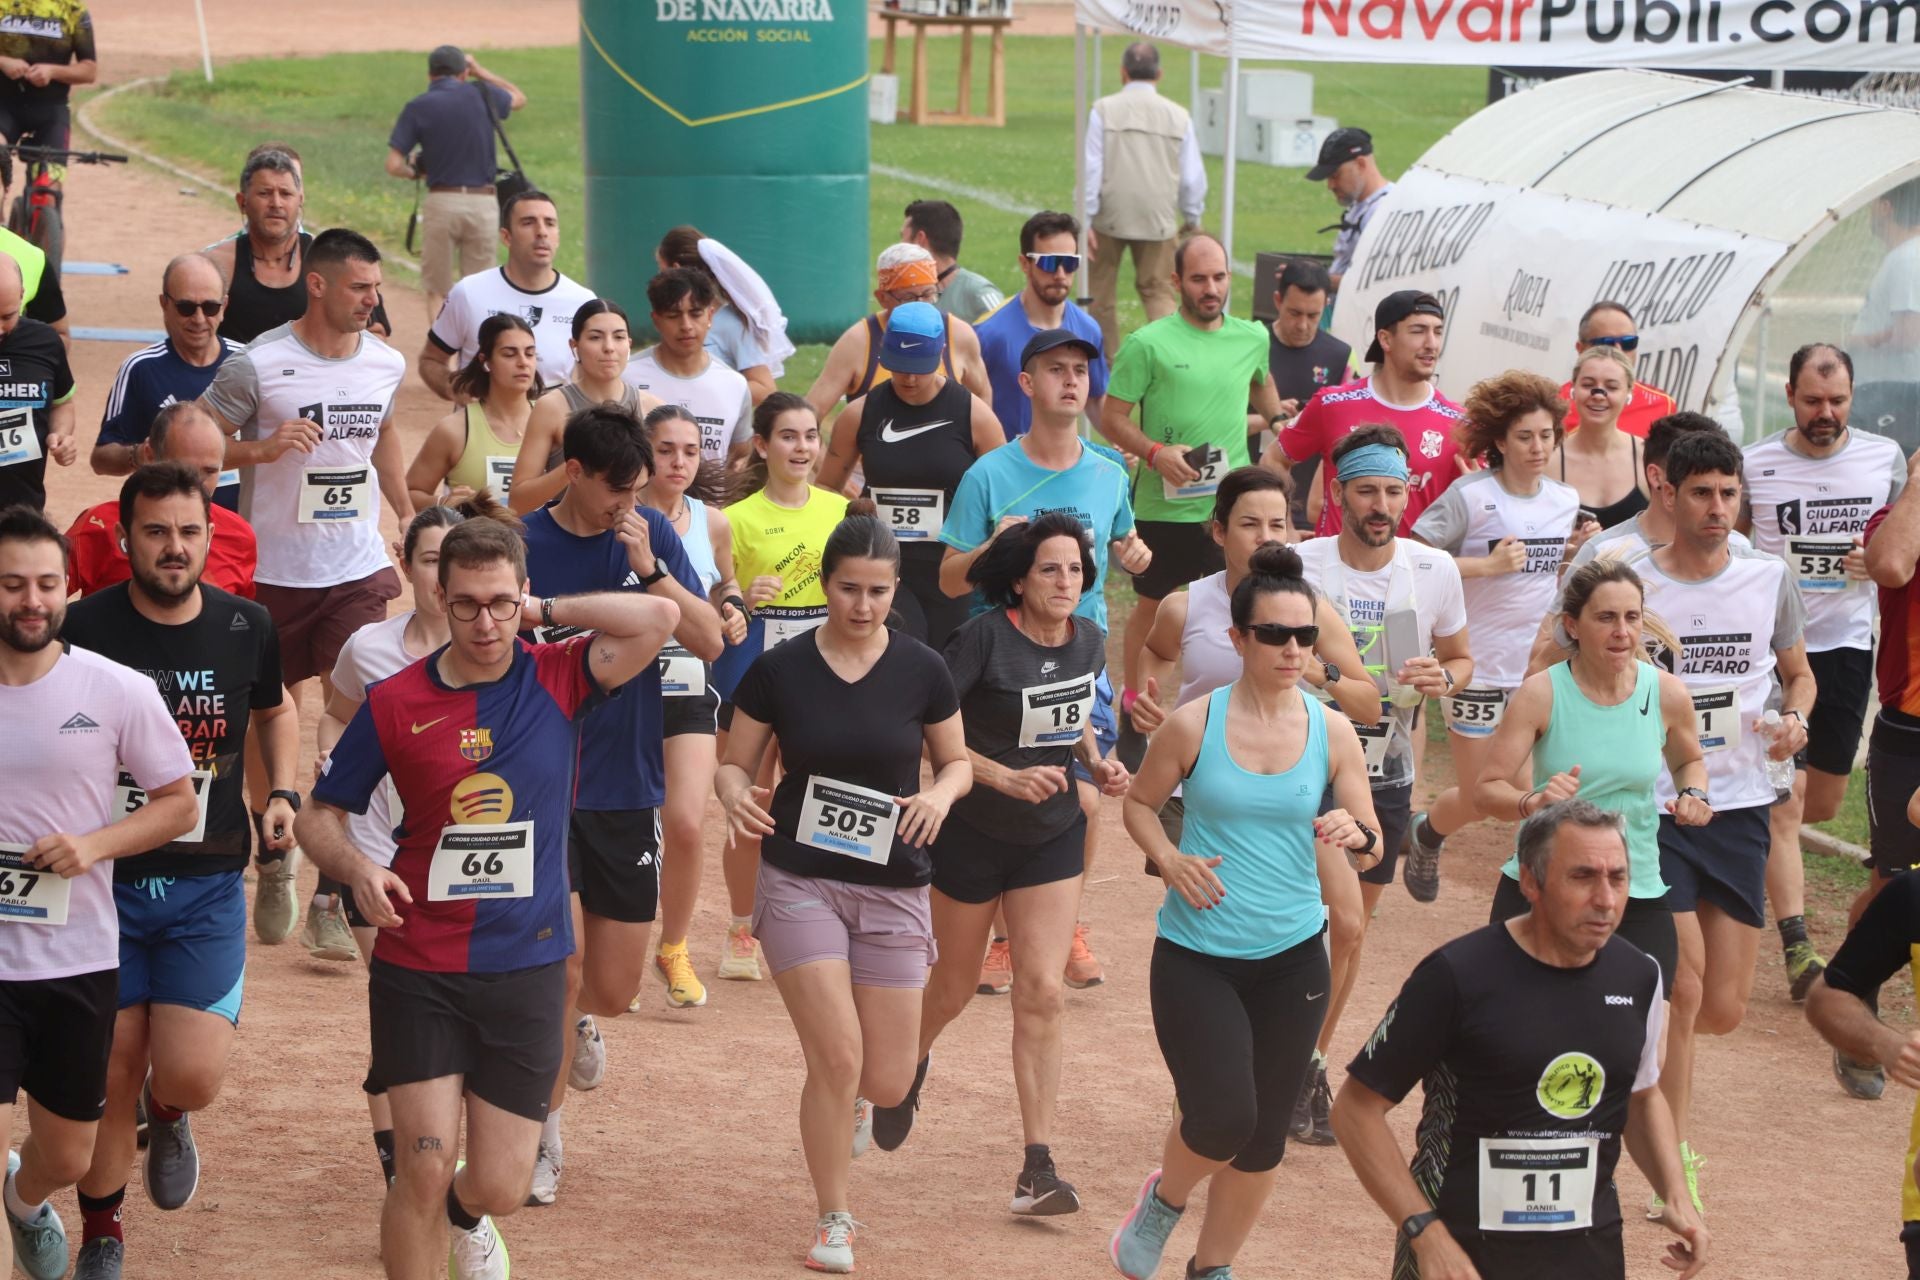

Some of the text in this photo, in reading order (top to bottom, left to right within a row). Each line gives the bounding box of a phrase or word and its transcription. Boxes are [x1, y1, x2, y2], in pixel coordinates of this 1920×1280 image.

[657, 0, 835, 21] DE NAVARRA
[686, 28, 812, 42] ACCIÓN SOCIAL
[328, 414, 372, 425] CIUDAD
[323, 486, 353, 506] 65
[891, 507, 921, 525] 58
[1806, 507, 1858, 520] CIUDAD
[774, 542, 807, 573] RINCON
[1800, 556, 1846, 575] 534
[783, 568, 824, 601] ATLETISM
[777, 608, 787, 616] DE
[1681, 645, 1751, 660] CIUDAD DE
[1680, 660, 1751, 675] ALFARO
[174, 670, 215, 691] WE
[176, 694, 225, 715] ARE
[1452, 701, 1496, 721] 535
[1051, 703, 1081, 727] 18
[178, 718, 227, 740] BAR
[190, 741, 218, 761] EL
[818, 804, 879, 838] 505
[828, 830, 858, 843] NATALIA
[461, 852, 504, 877] 66
[0, 872, 39, 898] 67
[1, 898, 27, 906] PABLO
[1522, 1173, 1561, 1202] 11
